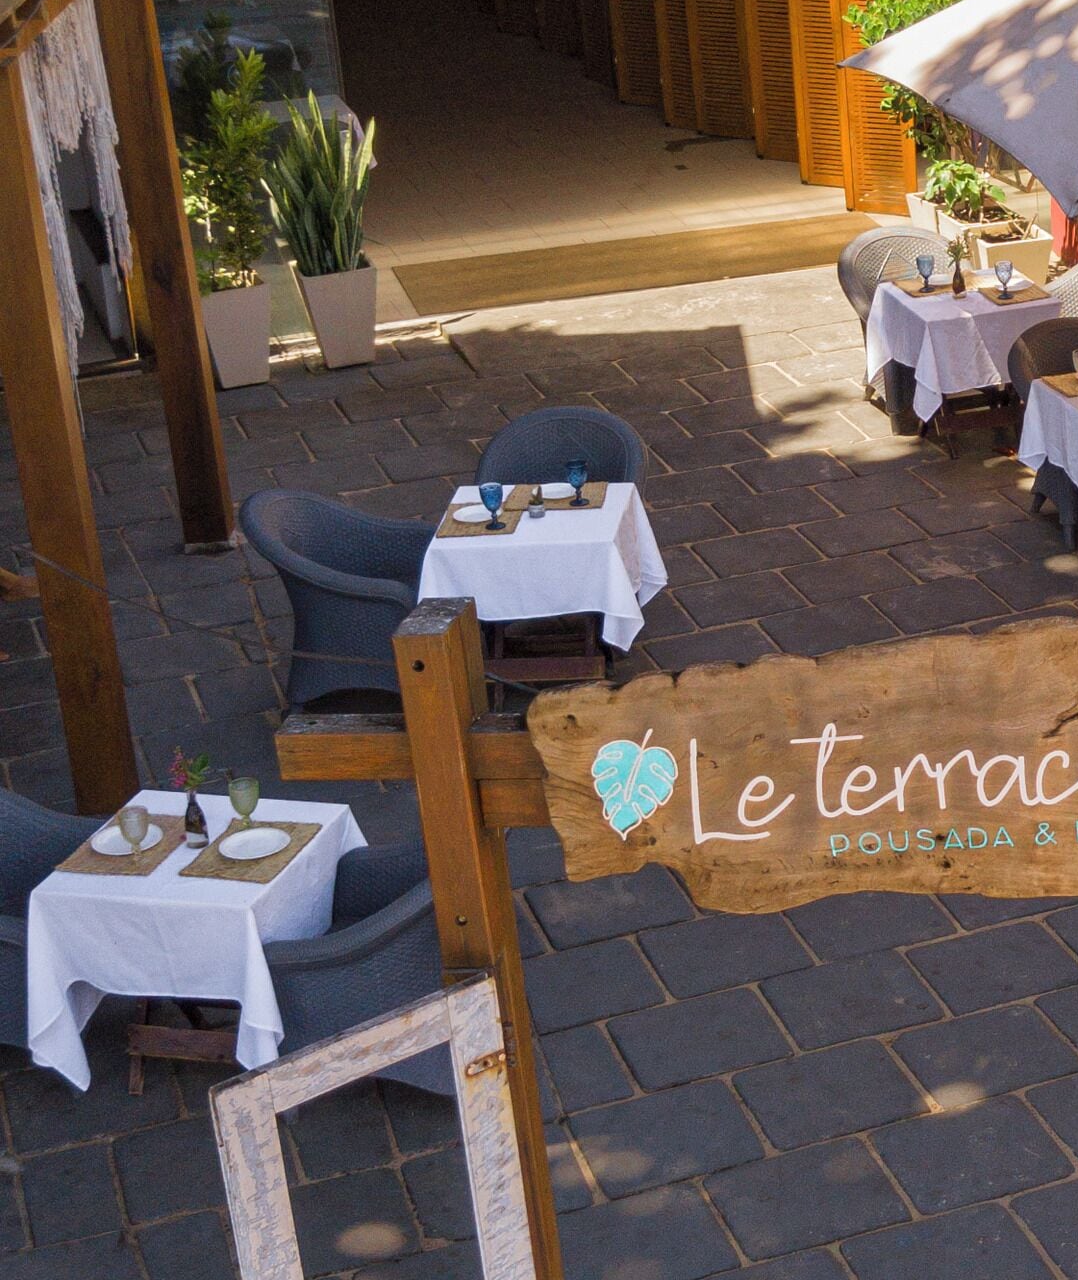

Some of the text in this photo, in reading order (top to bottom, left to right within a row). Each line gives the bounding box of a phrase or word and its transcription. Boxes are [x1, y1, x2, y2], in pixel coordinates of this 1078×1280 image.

[690, 738, 796, 844] Le
[829, 826, 1015, 857] POUSADA
[1034, 822, 1058, 846] &
